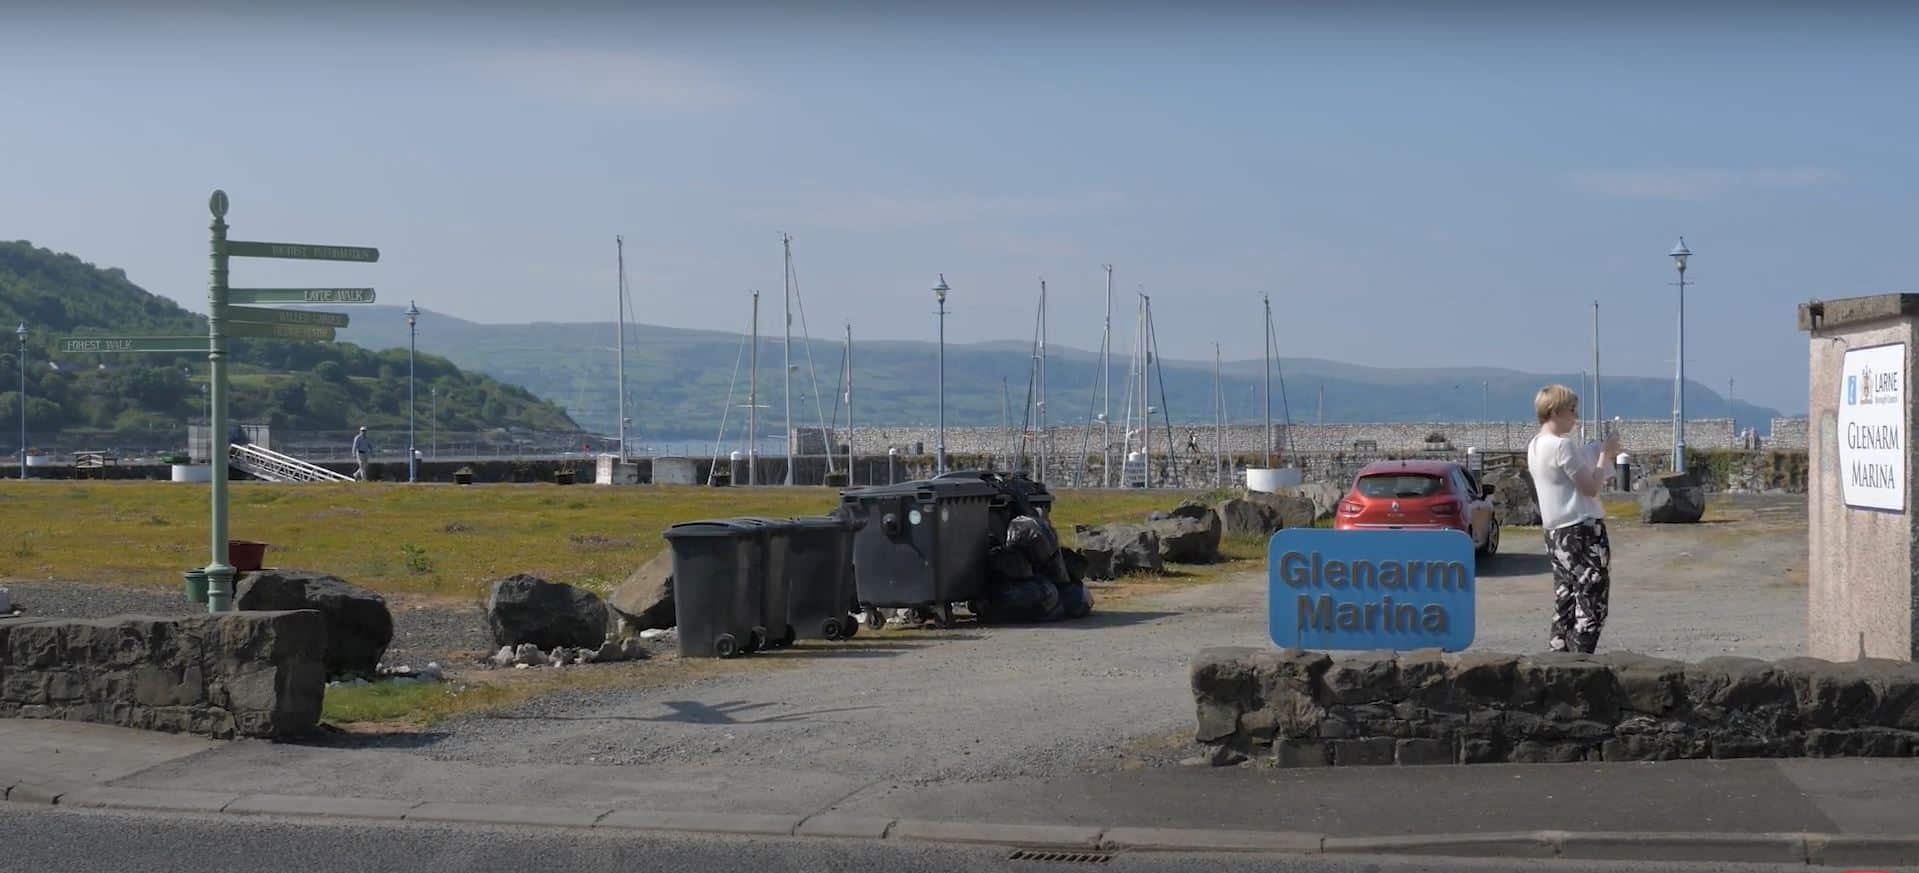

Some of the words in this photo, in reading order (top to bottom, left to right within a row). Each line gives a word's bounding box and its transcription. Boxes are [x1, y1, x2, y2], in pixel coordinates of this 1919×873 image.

[336, 290, 363, 301] WALK
[67, 340, 100, 350] FOREST
[106, 340, 132, 350] WALK
[1875, 371, 1898, 393] LARNE
[1847, 421, 1899, 450] GLENARM
[1852, 459, 1895, 489] MARINA
[1279, 551, 1466, 589] Glenarm
[1296, 593, 1448, 633] Marina
